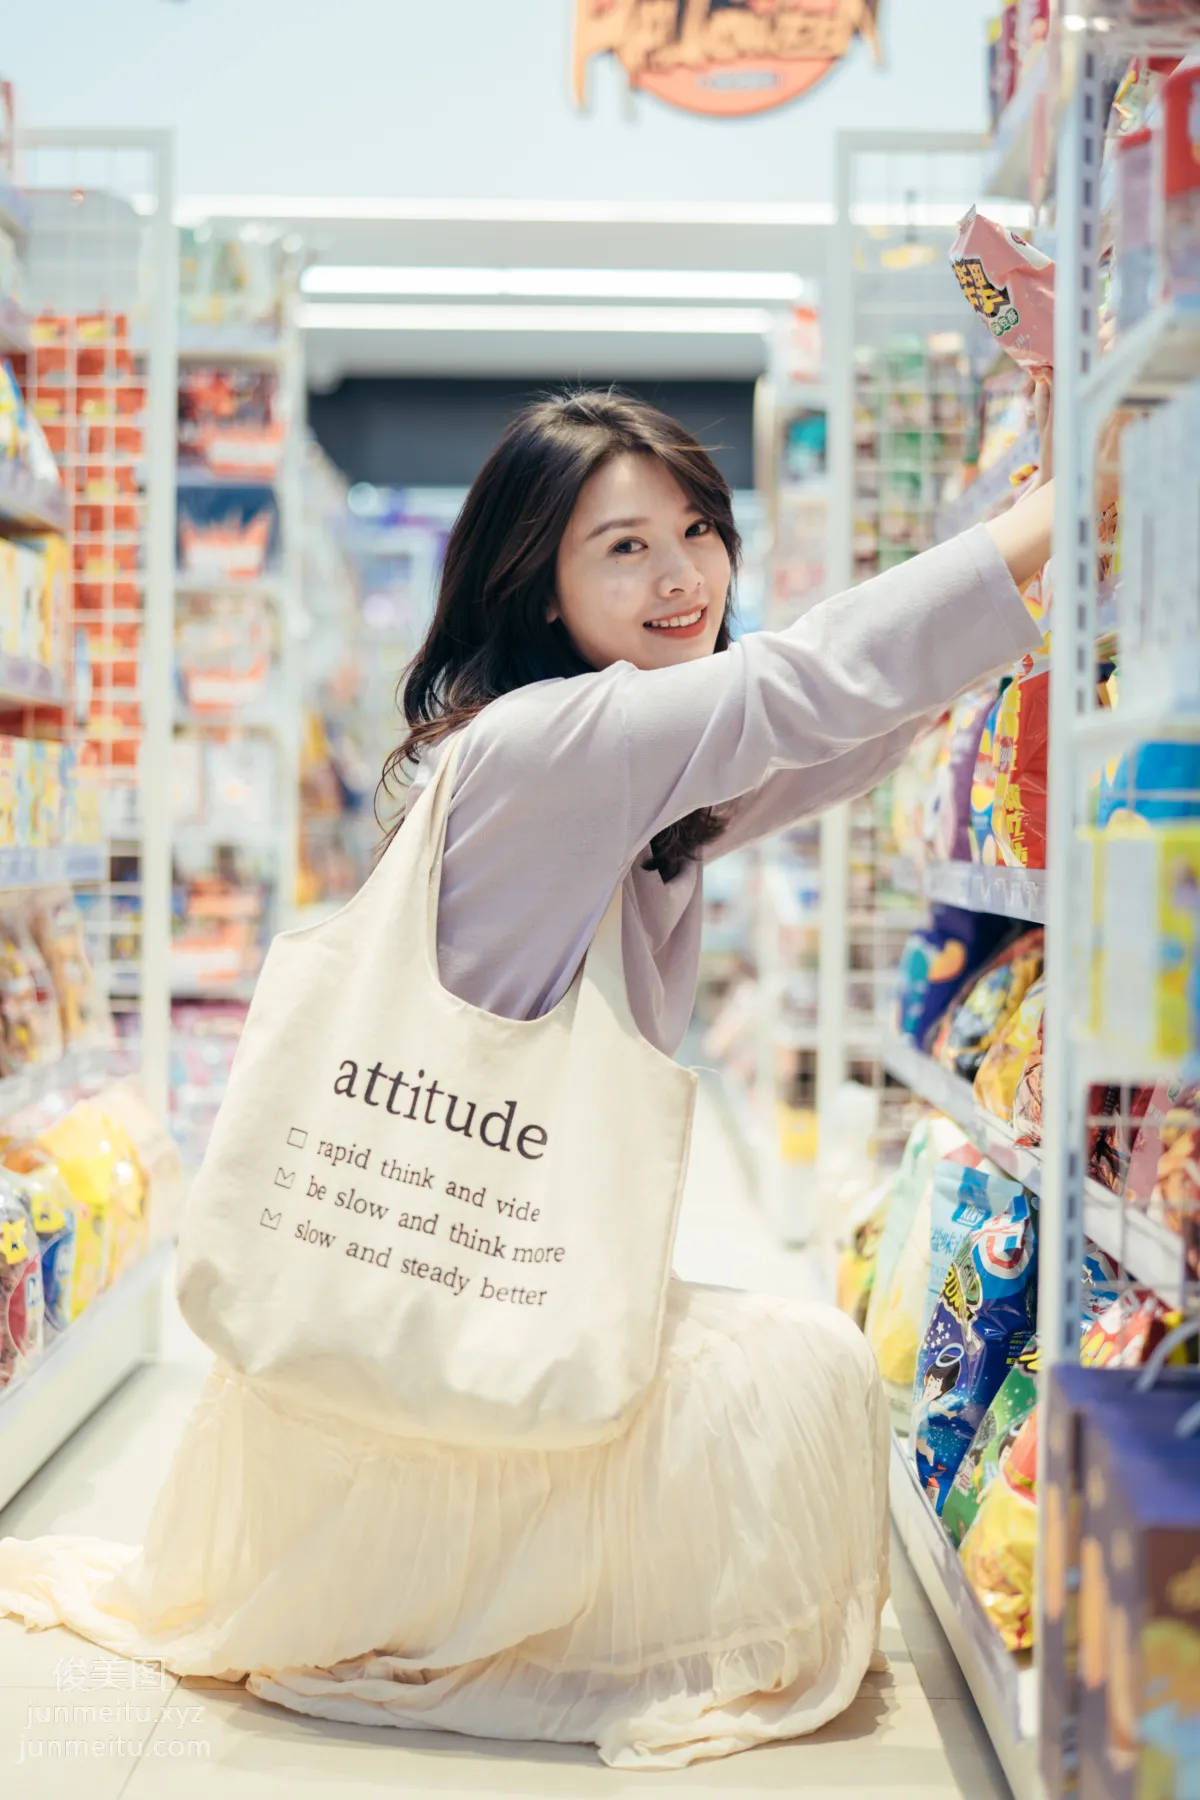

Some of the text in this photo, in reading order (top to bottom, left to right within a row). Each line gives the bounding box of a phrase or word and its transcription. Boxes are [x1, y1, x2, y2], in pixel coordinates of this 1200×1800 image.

[333, 1059, 549, 1161] attitude
[305, 1174, 567, 1264] be slow and think more
[316, 1138, 541, 1223] rapid think and vide
[294, 1219, 549, 1307] slow and steady better
